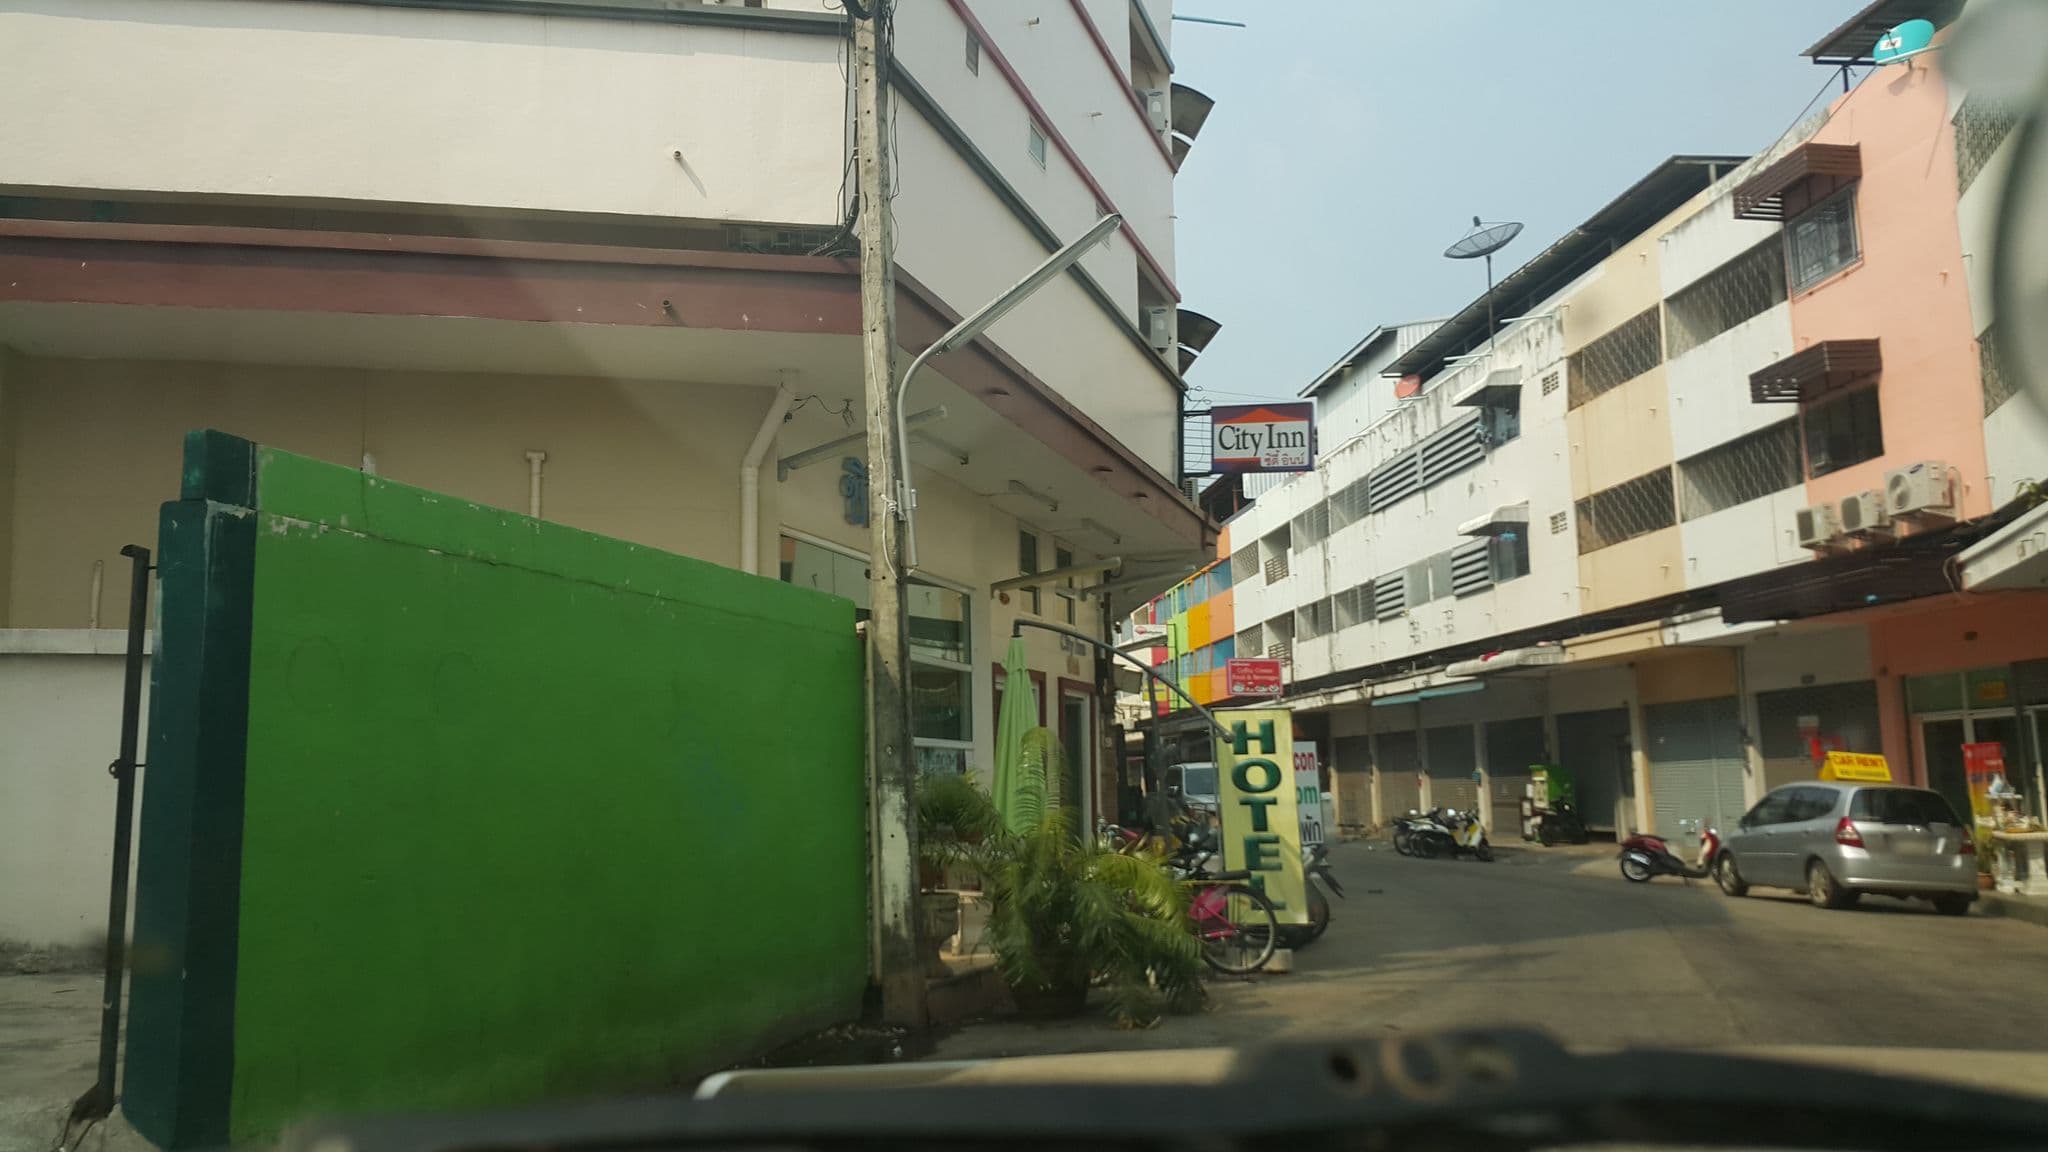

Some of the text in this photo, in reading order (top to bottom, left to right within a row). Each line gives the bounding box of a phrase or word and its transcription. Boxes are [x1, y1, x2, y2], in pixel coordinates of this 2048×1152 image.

[1218, 423, 1306, 457] City Inn
[1231, 718, 1287, 911] HOTEL
